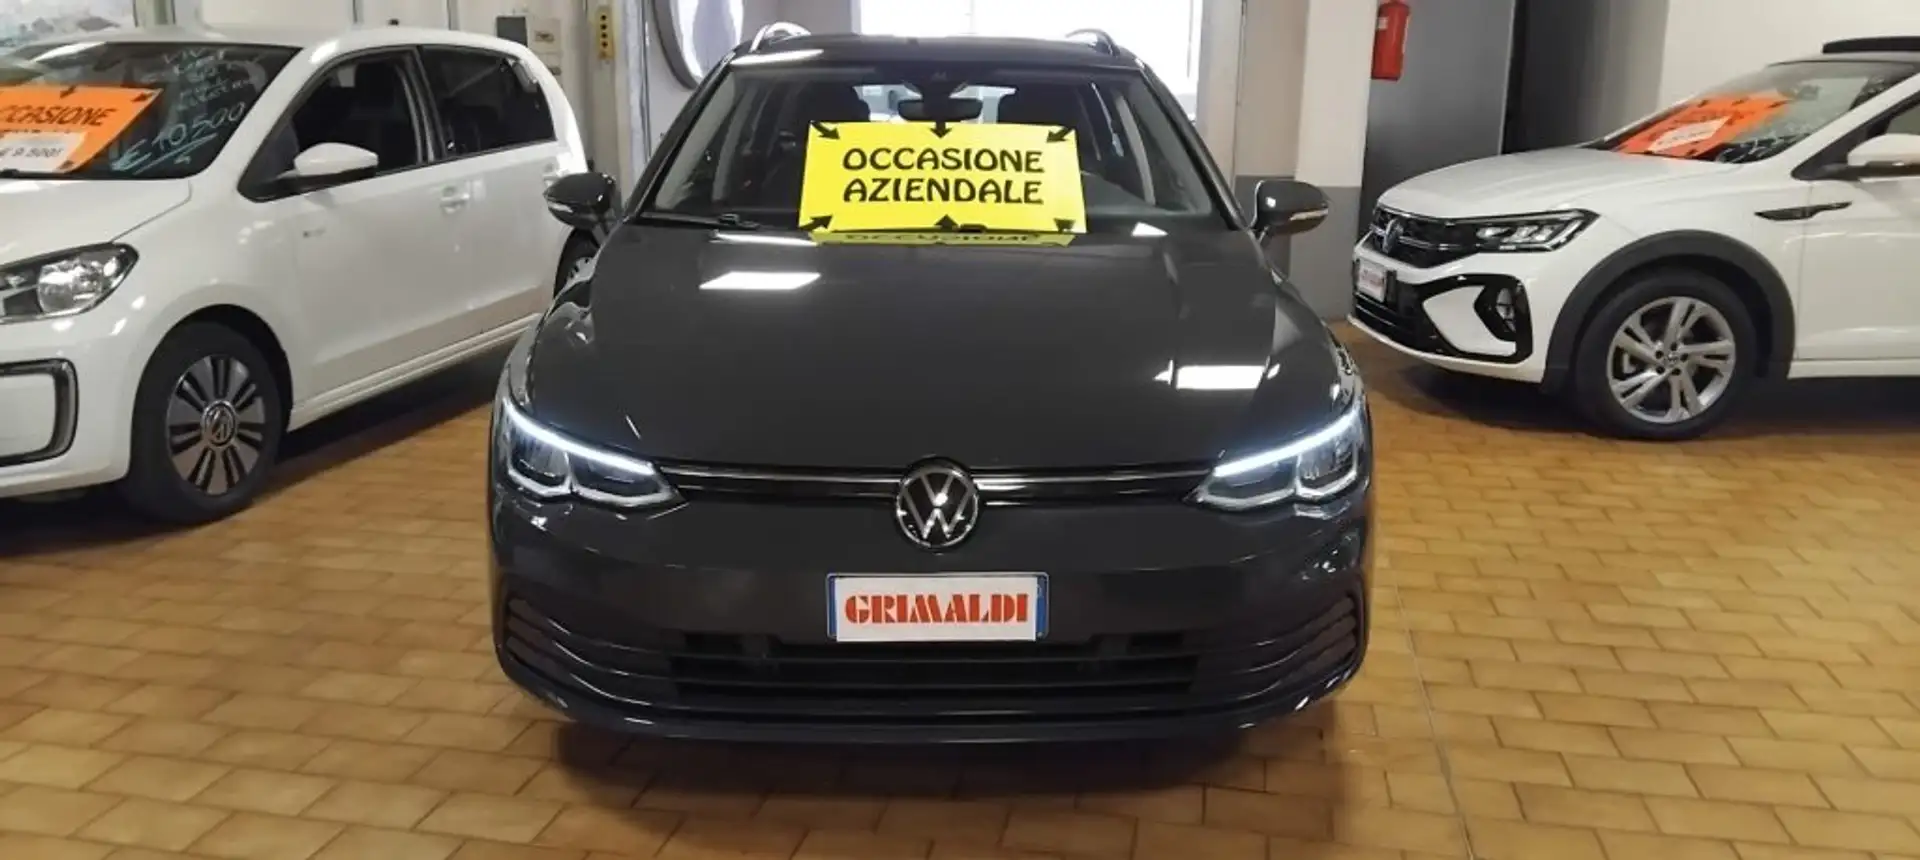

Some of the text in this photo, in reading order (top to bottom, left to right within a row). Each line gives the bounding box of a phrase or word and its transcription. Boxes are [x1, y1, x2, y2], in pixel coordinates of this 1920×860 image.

[842, 148, 1044, 173] OCCASIONE
[843, 178, 1043, 204] AZIENDALE
[844, 593, 1029, 624] GRIMALDI
